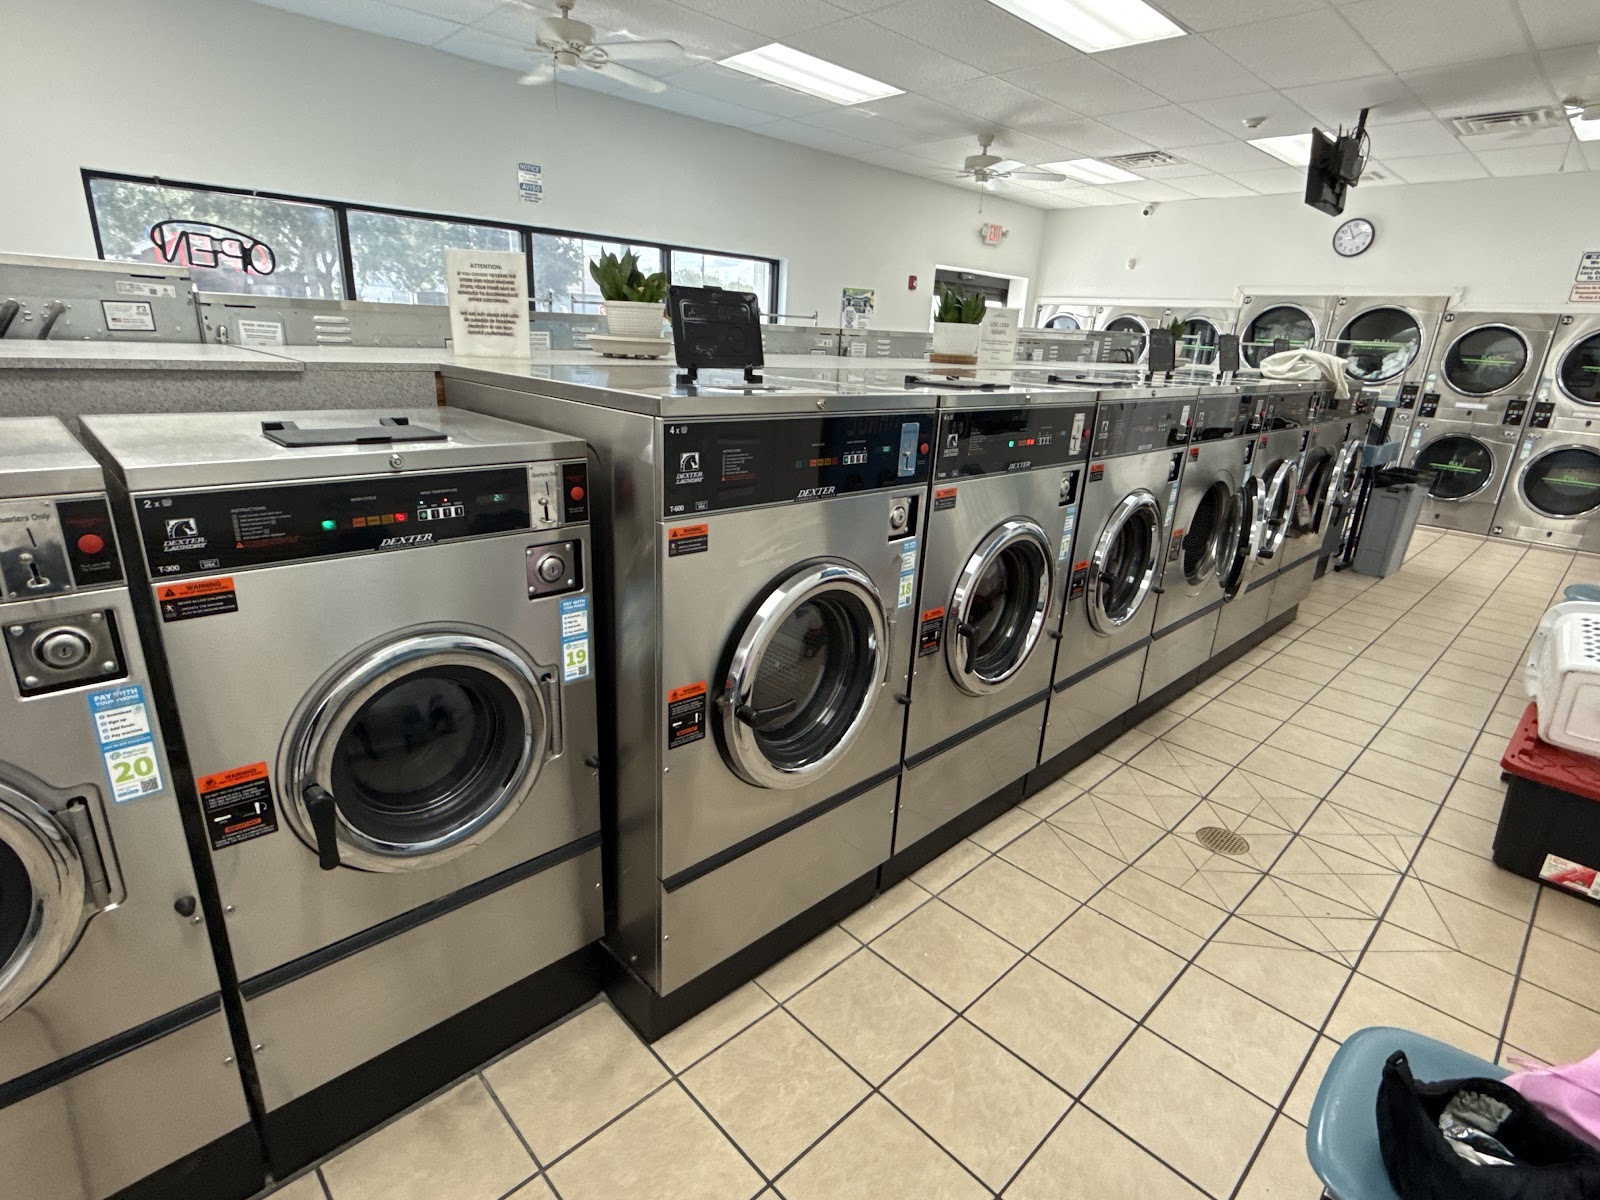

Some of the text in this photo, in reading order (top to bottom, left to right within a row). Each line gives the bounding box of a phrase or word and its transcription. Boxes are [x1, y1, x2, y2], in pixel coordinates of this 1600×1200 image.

[520, 164, 540, 172] NOTICE
[522, 184, 540, 192] AVISO
[990, 224, 1001, 240] EXIT
[670, 426, 674, 434] 4
[1008, 461, 1031, 470] DEXTER
[797, 486, 836, 497] DEXTER
[144, 500, 152, 508] 2
[164, 537, 207, 546] DEXTER
[380, 533, 433, 546] DEXTER
[164, 542, 207, 552] LAUNDRY
[158, 564, 180, 573] T-300
[186, 582, 221, 590] WARNING
[901, 582, 911, 596] 18
[567, 649, 586, 666] 19
[94, 693, 111, 702] PAY
[116, 693, 139, 702] PHONE
[107, 709, 132, 718] Download
[112, 756, 154, 783] 20
[225, 768, 257, 780] WARNING
